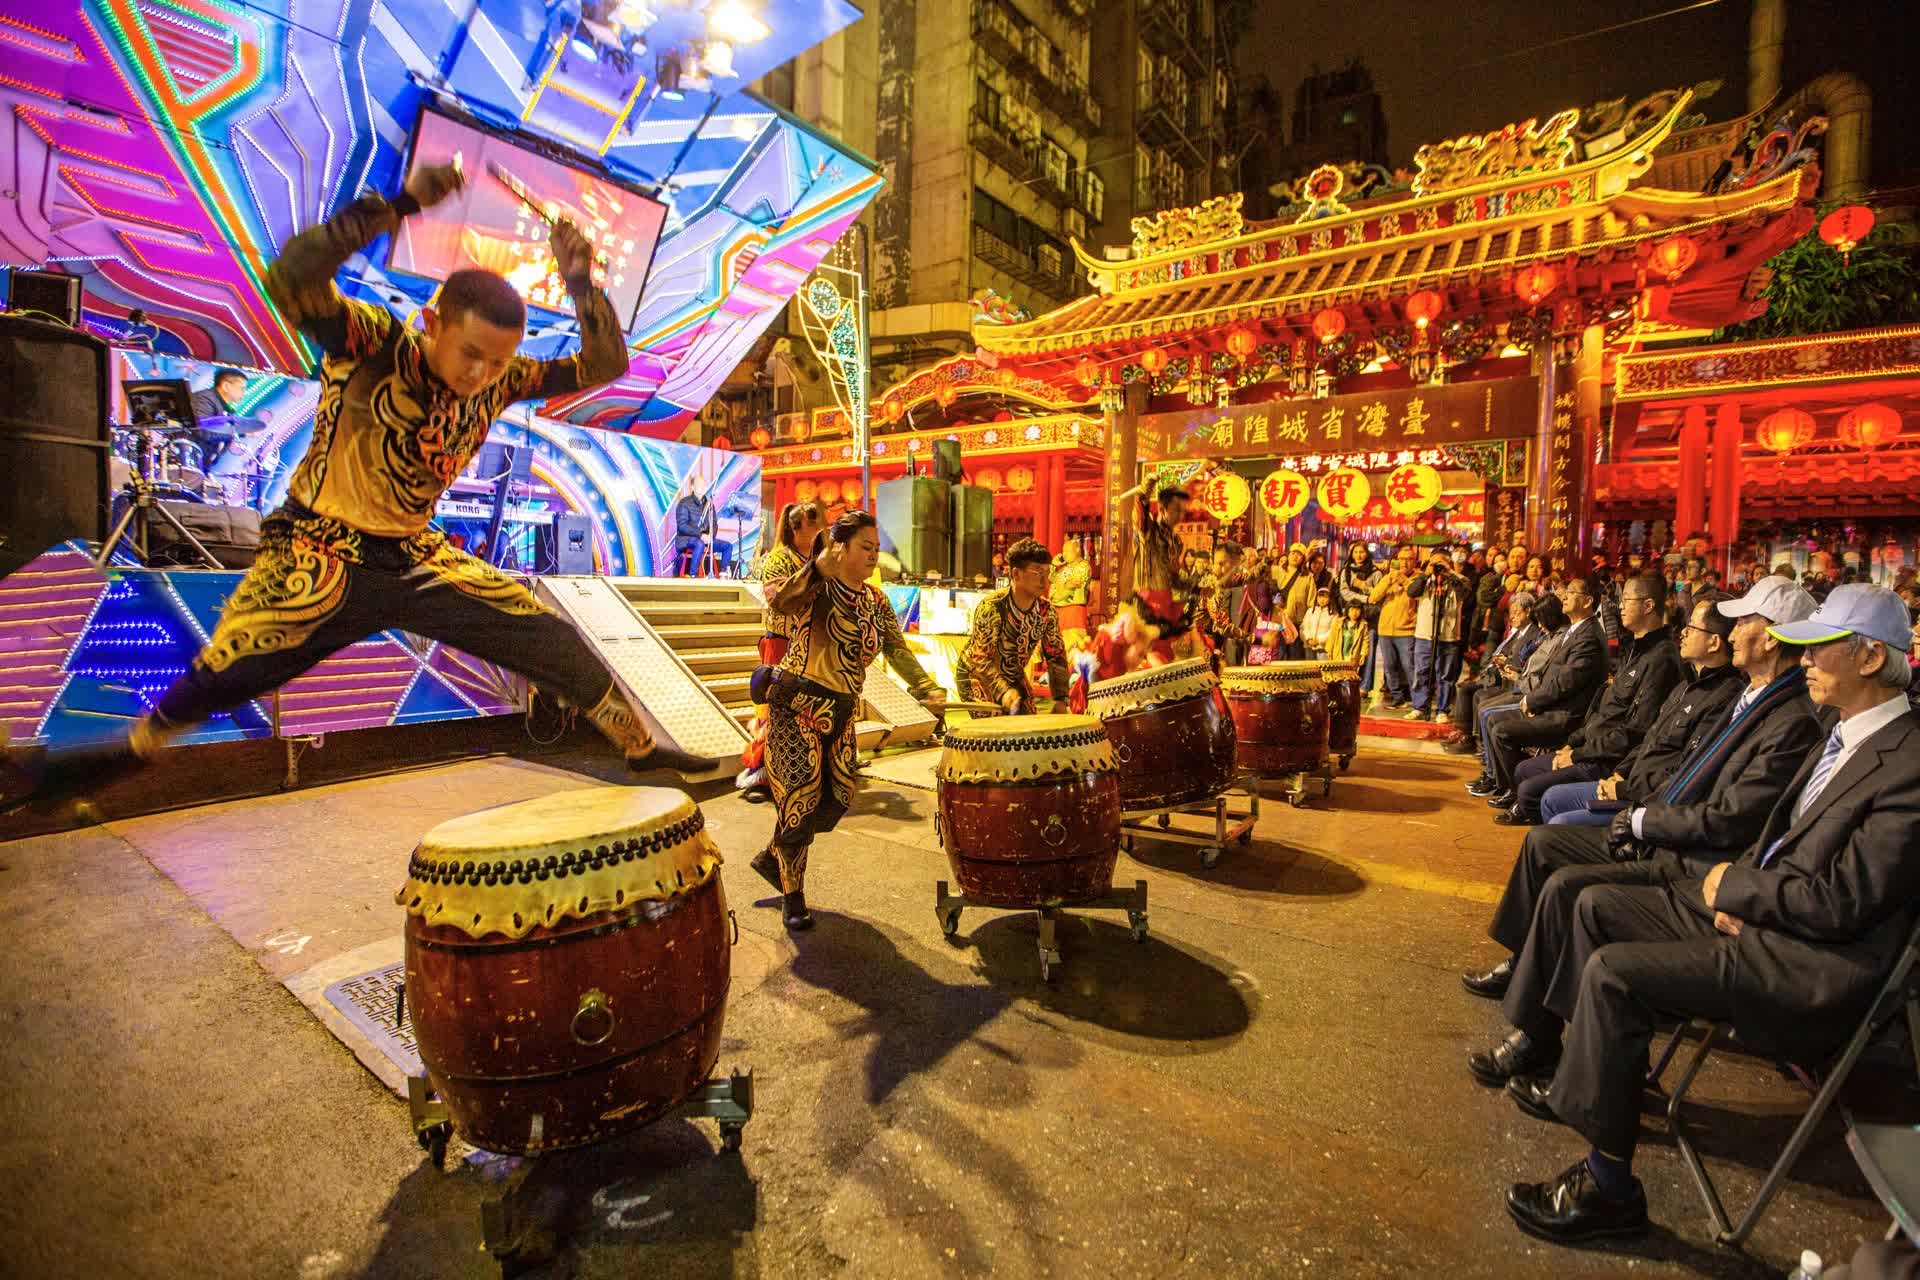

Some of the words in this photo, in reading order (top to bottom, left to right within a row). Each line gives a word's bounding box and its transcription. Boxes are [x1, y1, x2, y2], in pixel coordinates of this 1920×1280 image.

[1208, 397, 1431, 448] 臺灣省城隍廟
[456, 504, 480, 514] KORG
